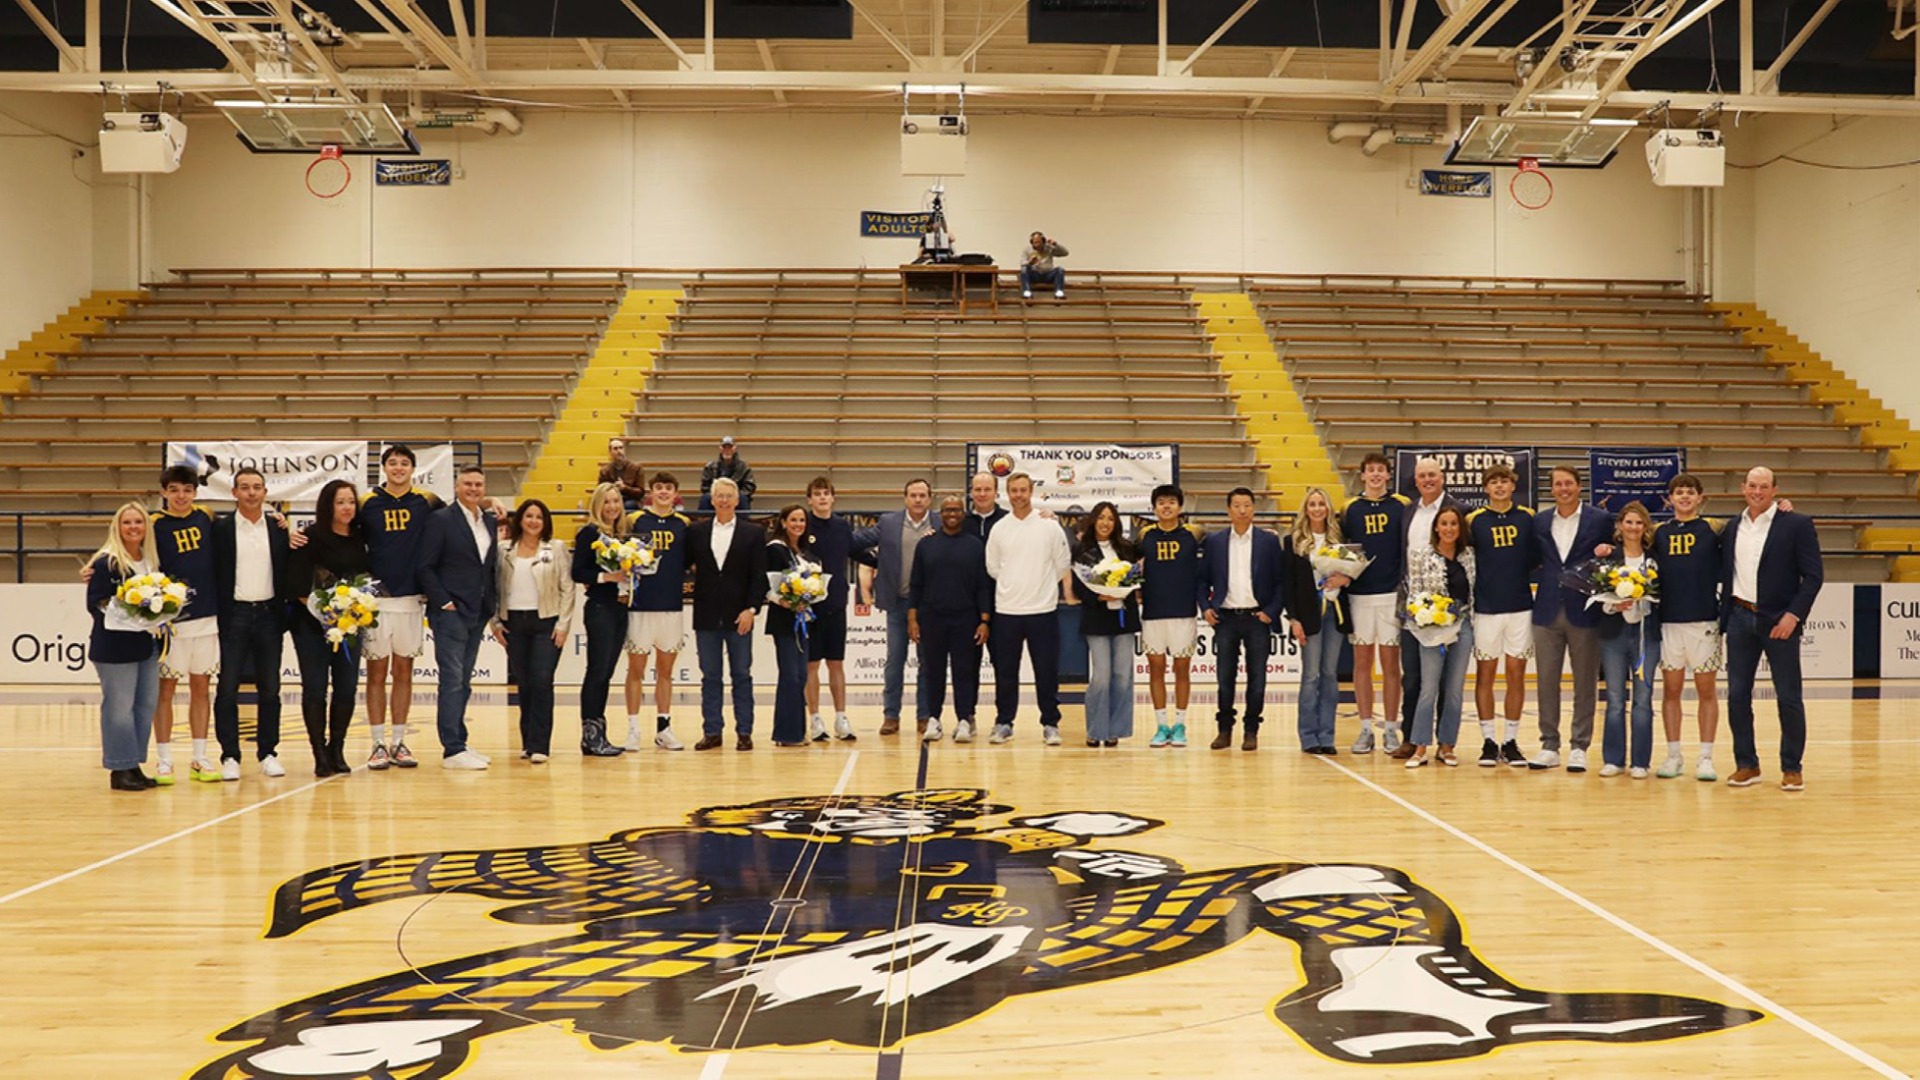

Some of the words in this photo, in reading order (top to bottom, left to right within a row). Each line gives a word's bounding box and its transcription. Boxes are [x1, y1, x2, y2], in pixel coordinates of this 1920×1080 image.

[867, 214, 930, 223] VISITOR
[868, 224, 928, 233] ADULTS
[228, 453, 361, 475] JOHNSON
[1020, 450, 1062, 460] THANK
[1065, 450, 1092, 460] YOU
[1096, 450, 1162, 460] SPONSORS
[1463, 454, 1515, 470] SCOTS
[1597, 457, 1631, 466] STEVEN
[1633, 459, 1638, 467] &
[1613, 470, 1660, 478] BRADFORD
[383, 508, 411, 532] HP
[1364, 512, 1388, 535] HP
[172, 526, 202, 553] HP
[651, 530, 675, 551] HP
[1490, 525, 1518, 548] HP
[1668, 533, 1696, 556] HP
[1156, 540, 1181, 561] HP
[11, 633, 85, 671] Orig
[1897, 647, 1919, 659] The
